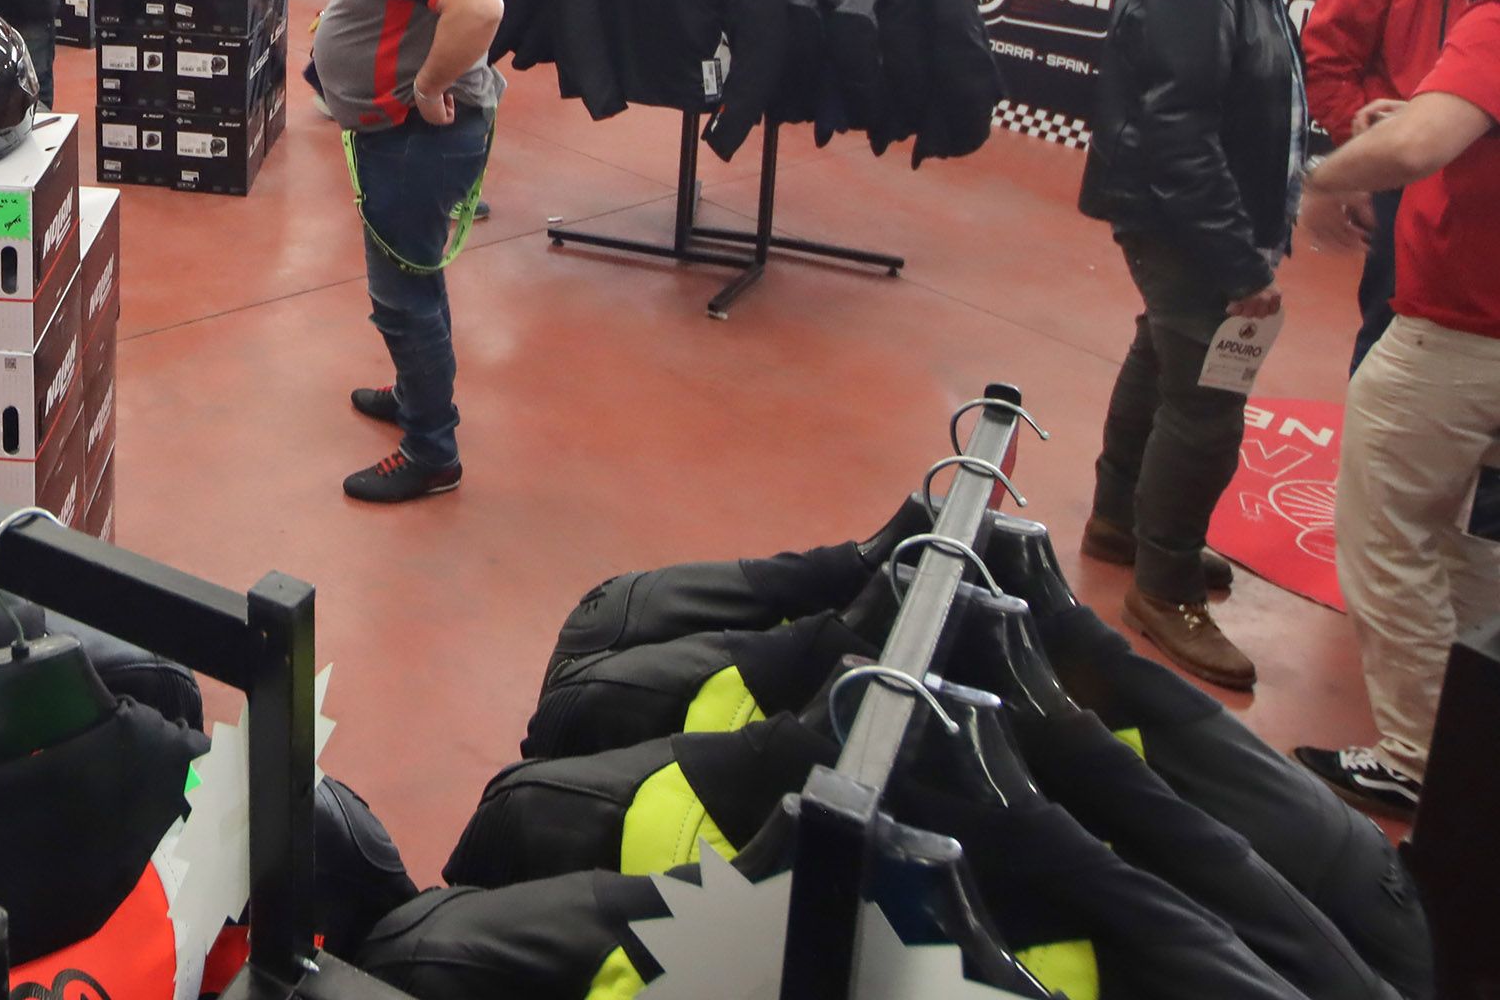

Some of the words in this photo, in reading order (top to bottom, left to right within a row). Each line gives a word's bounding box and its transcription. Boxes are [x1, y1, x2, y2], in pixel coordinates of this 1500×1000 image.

[1046, 53, 1089, 75] SPAIN
[43, 187, 74, 260] NOLAN
[88, 253, 115, 320] NOLAN
[45, 334, 77, 417] NOLAN
[88, 379, 114, 453] NOLAN
